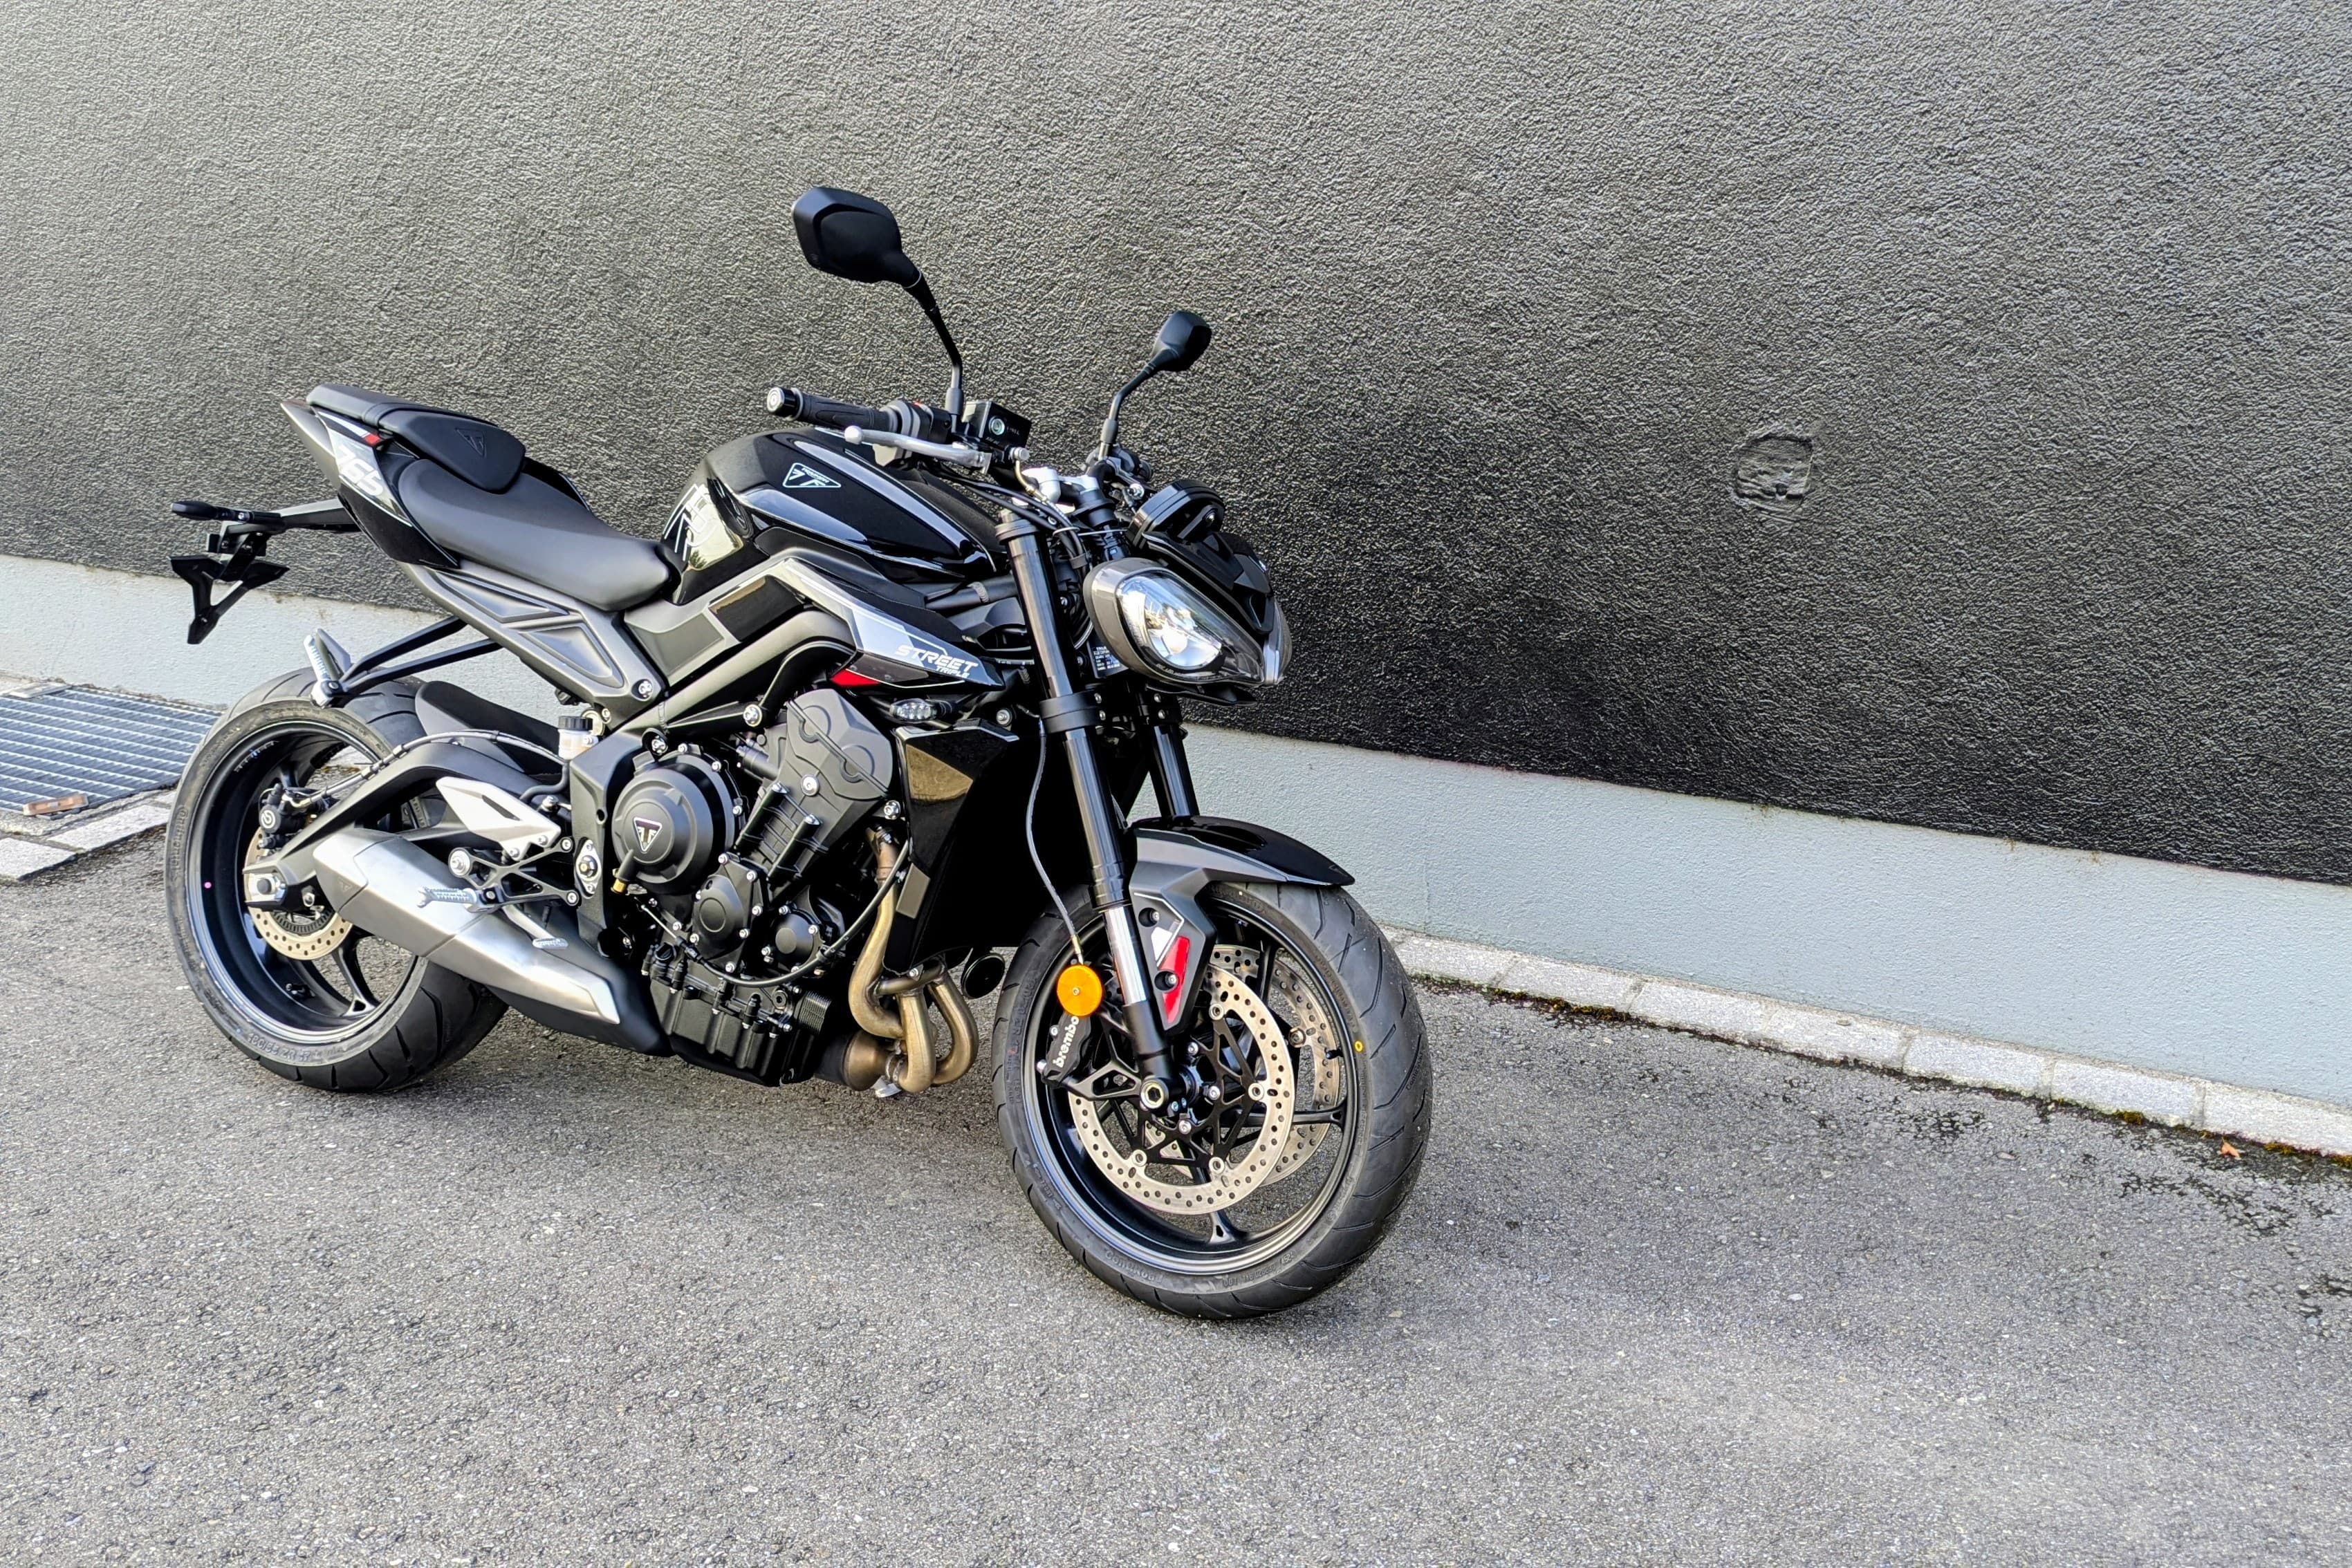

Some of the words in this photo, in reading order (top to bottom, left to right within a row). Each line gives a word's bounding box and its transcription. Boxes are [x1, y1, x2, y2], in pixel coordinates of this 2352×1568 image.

[895, 645, 979, 672] STREET
[935, 665, 970, 678] TRIPLE
[1052, 1016, 1080, 1068] brembo
